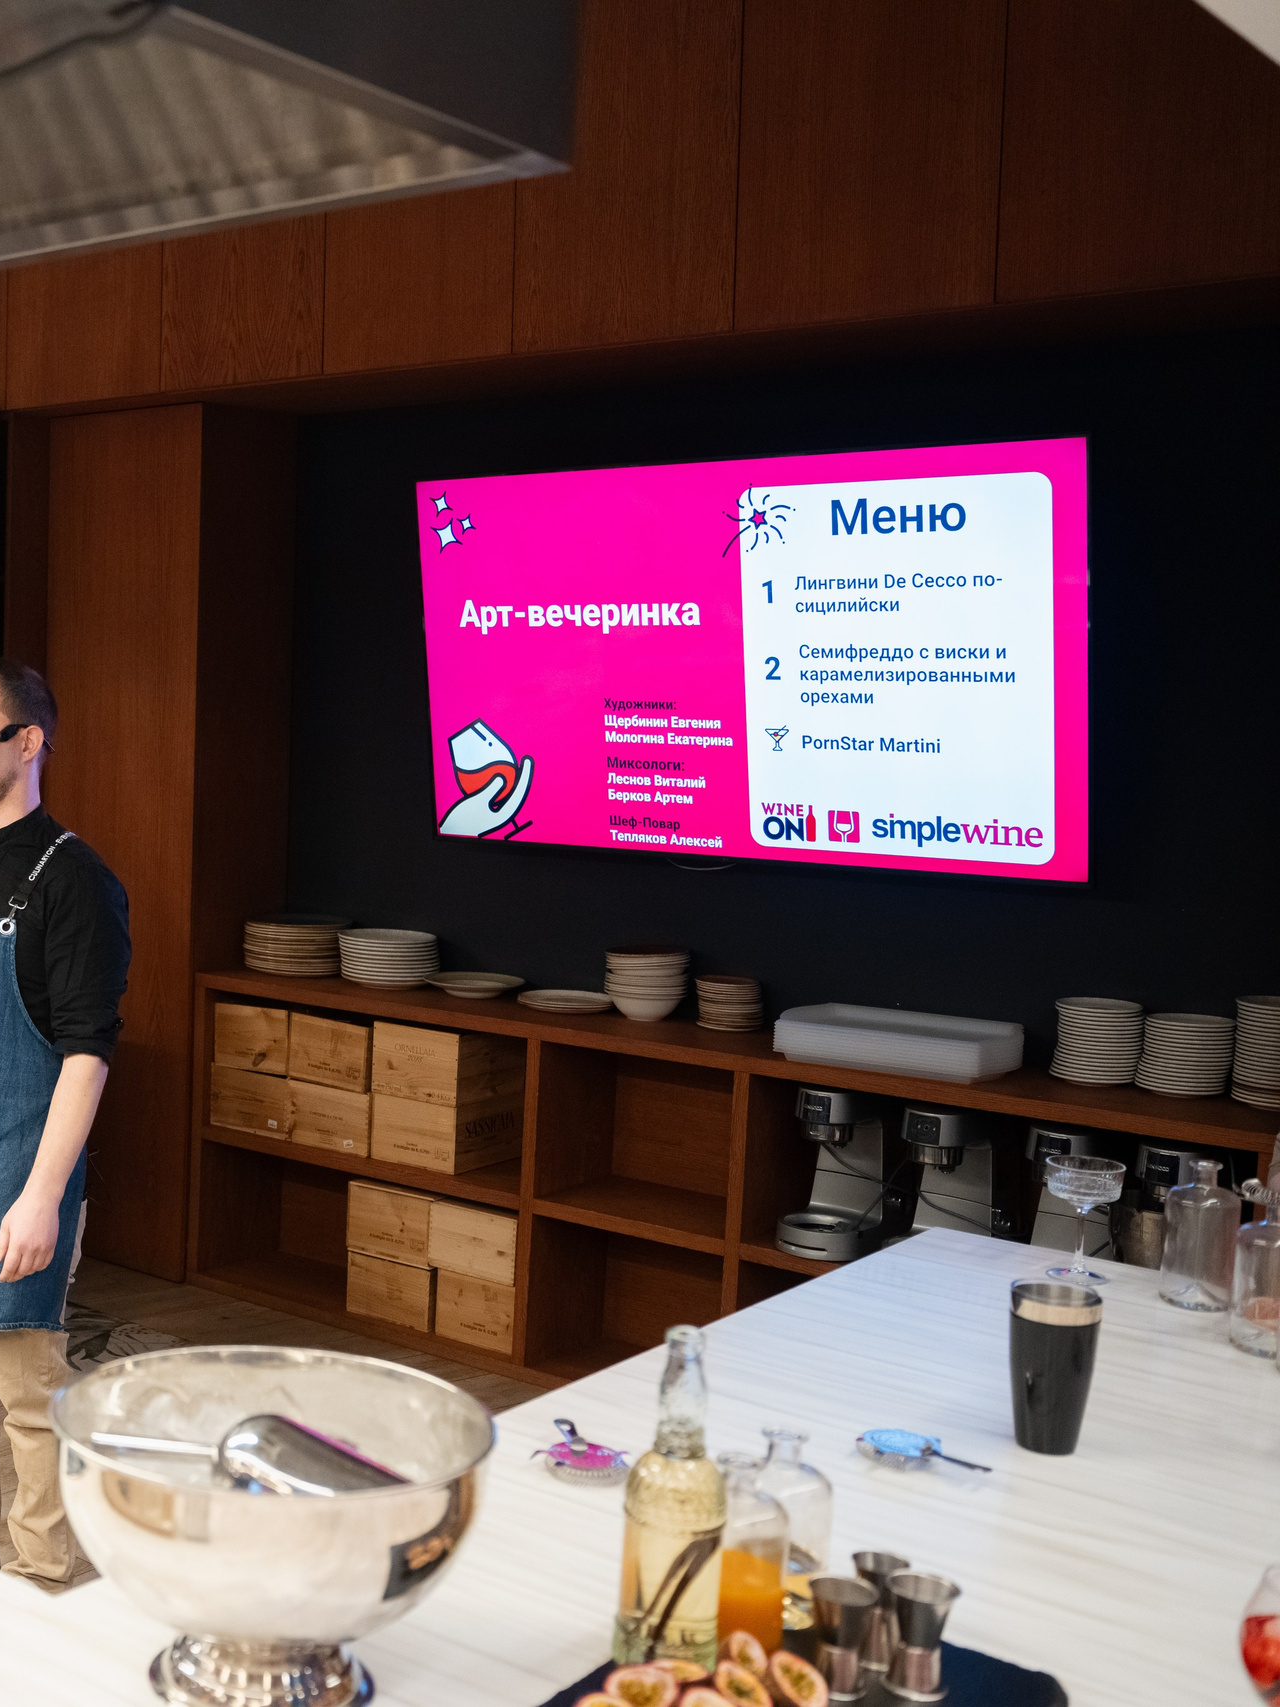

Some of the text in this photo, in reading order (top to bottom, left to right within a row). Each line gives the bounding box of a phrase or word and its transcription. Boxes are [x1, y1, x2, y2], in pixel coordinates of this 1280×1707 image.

[831, 498, 967, 536] Меню
[795, 573, 1003, 591] Лингвини De Cecco по-
[762, 580, 773, 604] 1
[795, 597, 900, 615] сицилийски
[459, 599, 701, 635] Арт-вечеринка
[799, 644, 1007, 662] Семифреддо с виски и
[764, 656, 782, 681] 2
[800, 670, 1016, 685] карамелизированными
[604, 698, 677, 711] Художники:
[800, 692, 874, 706] орехами
[604, 715, 722, 729] Щербинин Евгения
[605, 731, 734, 748] Мологина Екатерина
[802, 735, 941, 753] PornStar Martini
[606, 756, 685, 771] Миксологи:
[607, 772, 706, 789] Леснов Виталий
[608, 789, 693, 806] Берков Артем
[762, 802, 804, 817] WINE
[609, 815, 681, 832] Шеф-Повар
[871, 813, 1044, 848] simplewine
[610, 829, 723, 848] Тепляков Алексей
[28, 845, 56, 882] CULINARYON
[394, 1043, 436, 1058] ORNELLAIA
[464, 1111, 516, 1139] SASSICAIA
